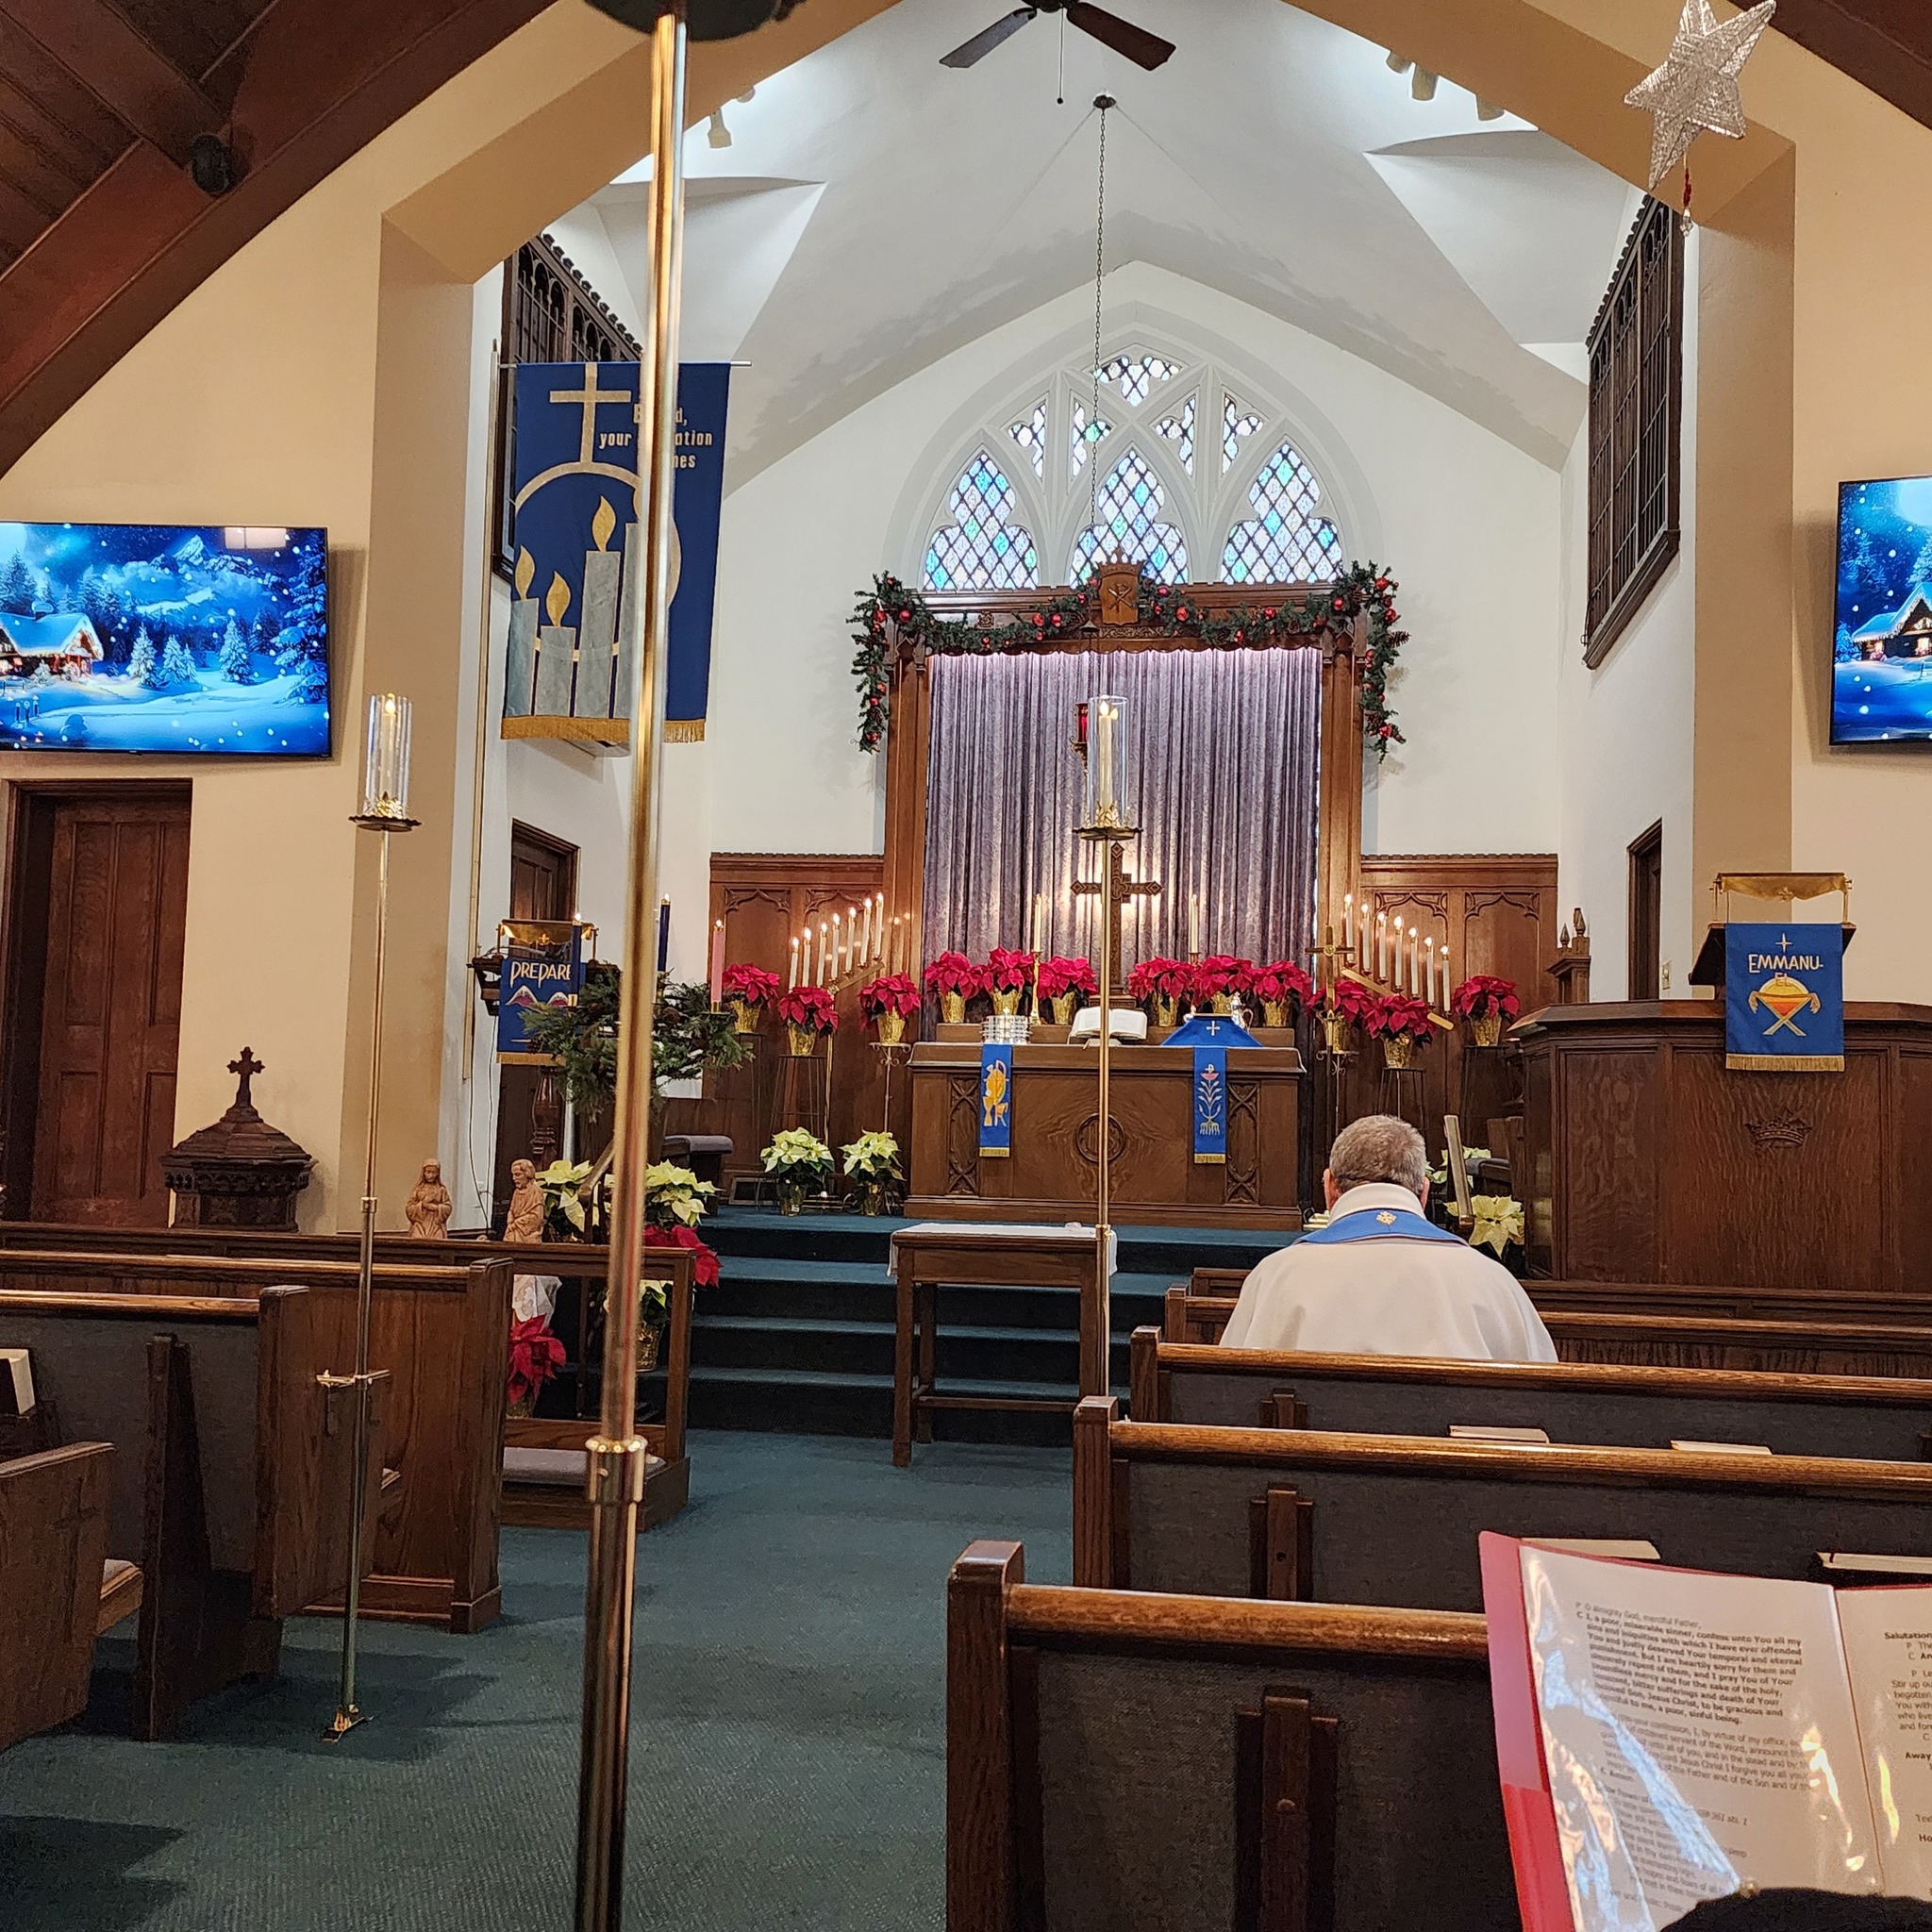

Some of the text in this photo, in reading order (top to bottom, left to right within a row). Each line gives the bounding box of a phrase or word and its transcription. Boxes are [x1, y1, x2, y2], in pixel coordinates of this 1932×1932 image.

[599, 431, 632, 449] your
[1749, 954, 1824, 973] EMMANU-
[1661, 1636, 1680, 1645] with
[1682, 1640, 1707, 1649] which
[1715, 1642, 1737, 1652] have
[1761, 1647, 1802, 1656] offended
[1731, 1634, 1752, 1642] unto
[1754, 1636, 1772, 1644] You
[1774, 1636, 1785, 1644] all
[1788, 1638, 1802, 1648] my
[1647, 1644, 1684, 1656] deserved
[1687, 1649, 1707, 1658] Your
[1709, 1653, 1749, 1663] temporal
[1770, 1657, 1803, 1666] eternal
[1679, 1657, 1711, 1670] heartily
[1713, 1663, 1737, 1673] sorry
[1738, 1665, 1752, 1673] for
[1754, 1666, 1777, 1675] them
[1779, 1667, 1797, 1675] and
[1661, 1676, 1677, 1684] and
[1679, 1678, 1691, 1686] for
[1692, 1681, 1707, 1689] the
[1710, 1682, 1729, 1691] sake
[1742, 1686, 1760, 1694] the
[1694, 1670, 1709, 1679] and
[1718, 1674, 1738, 1684] pray
[1740, 1675, 1757, 1683] You
[1771, 1678, 1793, 1686] Your
[1700, 1691, 1716, 1700] and
[1719, 1694, 1744, 1703] death
[1758, 1697, 1779, 1706] Your
[1893, 1691, 1932, 1700] begotten
[1701, 1701, 1712, 1709] to
[1713, 1703, 1724, 1711] be
[1726, 1705, 1763, 1715] gracious
[1765, 1708, 1783, 1716] and
[1689, 1711, 1713, 1721] sinful
[1715, 1714, 1743, 1725] being.
[1905, 1751, 1932, 1761] Away
